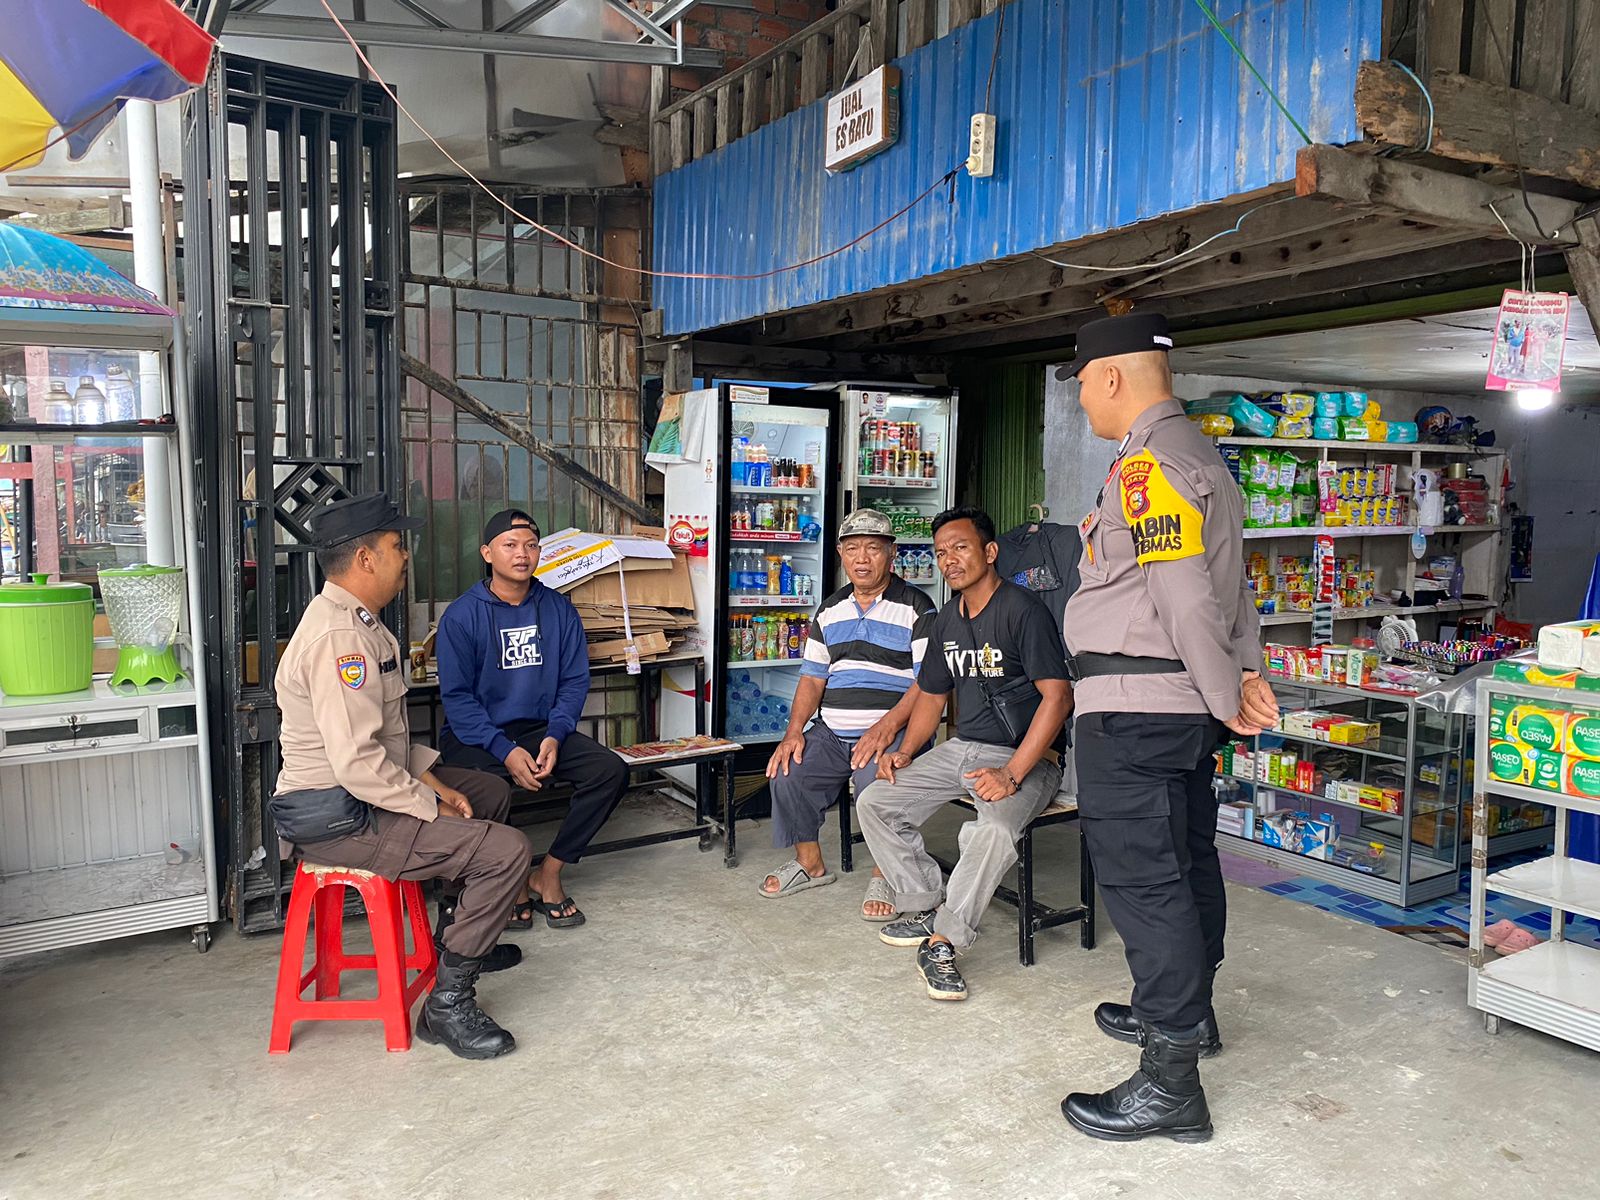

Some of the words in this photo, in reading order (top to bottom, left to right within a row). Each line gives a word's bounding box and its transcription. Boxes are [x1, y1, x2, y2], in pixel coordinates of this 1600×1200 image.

[840, 88, 863, 120] JUAL
[835, 125, 847, 152] ES
[848, 108, 874, 144] BATU
[507, 628, 537, 647] RIP
[506, 644, 541, 661] CURL
[1521, 729, 1552, 745] PASEO
[1491, 751, 1520, 765] PASEO
